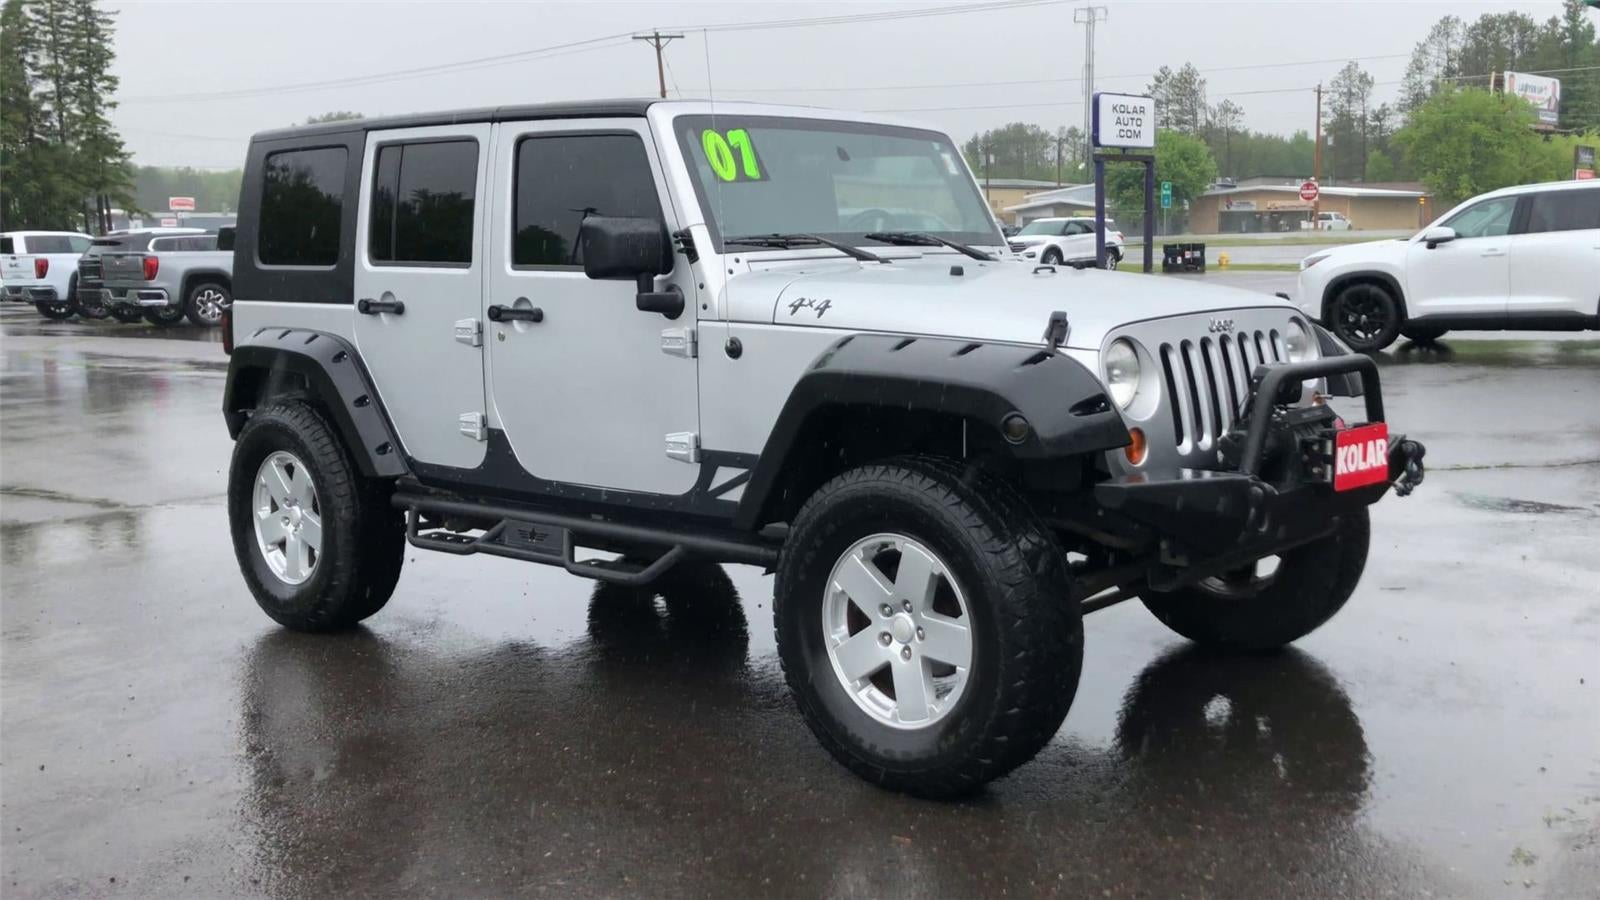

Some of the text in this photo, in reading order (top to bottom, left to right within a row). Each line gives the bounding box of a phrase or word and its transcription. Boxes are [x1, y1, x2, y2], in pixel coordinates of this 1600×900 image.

[1112, 104, 1145, 115] KOLAR
[1115, 116, 1142, 127] AUTO
[1116, 129, 1141, 139] .COM
[1208, 316, 1234, 333] Jeep
[1336, 439, 1388, 475] KOLAR
